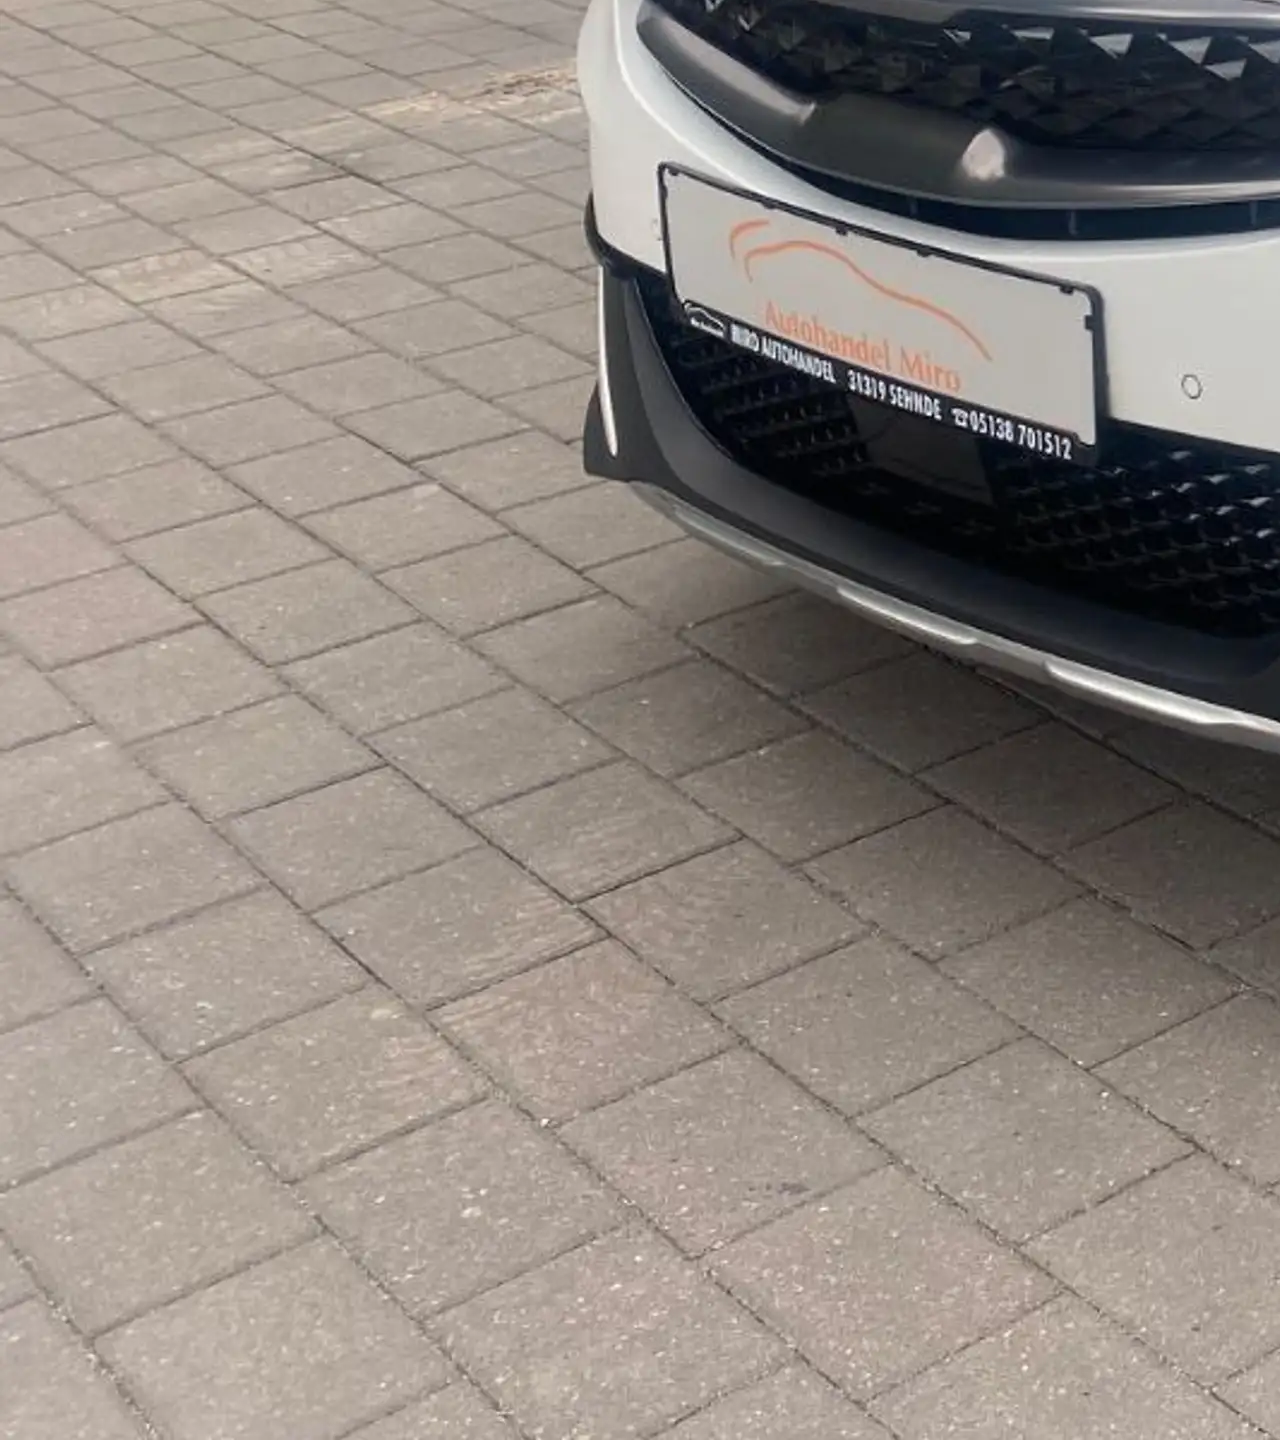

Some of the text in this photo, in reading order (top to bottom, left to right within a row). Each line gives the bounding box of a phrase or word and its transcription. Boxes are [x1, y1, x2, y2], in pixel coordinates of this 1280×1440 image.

[731, 323, 760, 352] MIRO
[761, 335, 837, 385] AUTOHANDEL
[848, 369, 887, 402] 31319
[889, 383, 943, 421] SEHNDE
[970, 410, 1014, 442] 05138
[1017, 423, 1073, 460] 701512
[765, 299, 962, 394] Autohandel Miro
